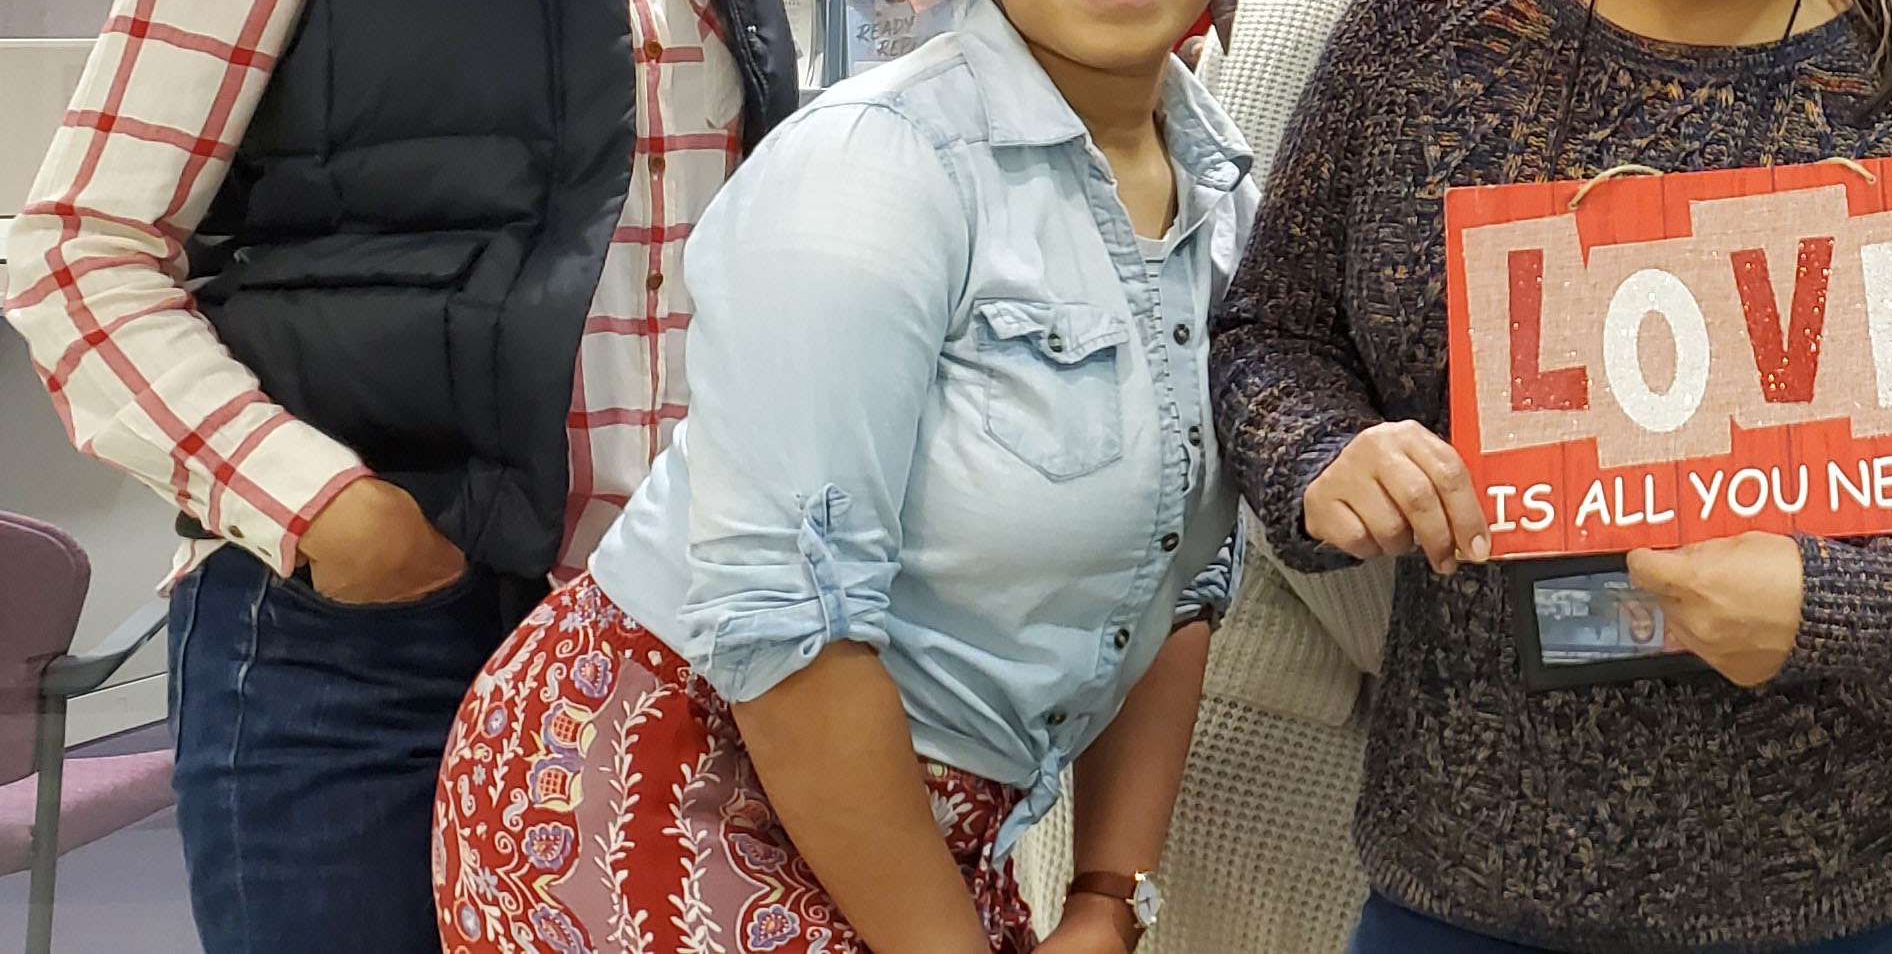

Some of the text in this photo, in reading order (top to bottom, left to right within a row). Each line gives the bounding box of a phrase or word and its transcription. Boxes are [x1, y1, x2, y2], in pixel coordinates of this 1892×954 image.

[856, 15, 916, 44] READY
[1487, 484, 1555, 532] IS
[1575, 475, 1674, 527] ALL
[1688, 464, 1808, 520] YOU
